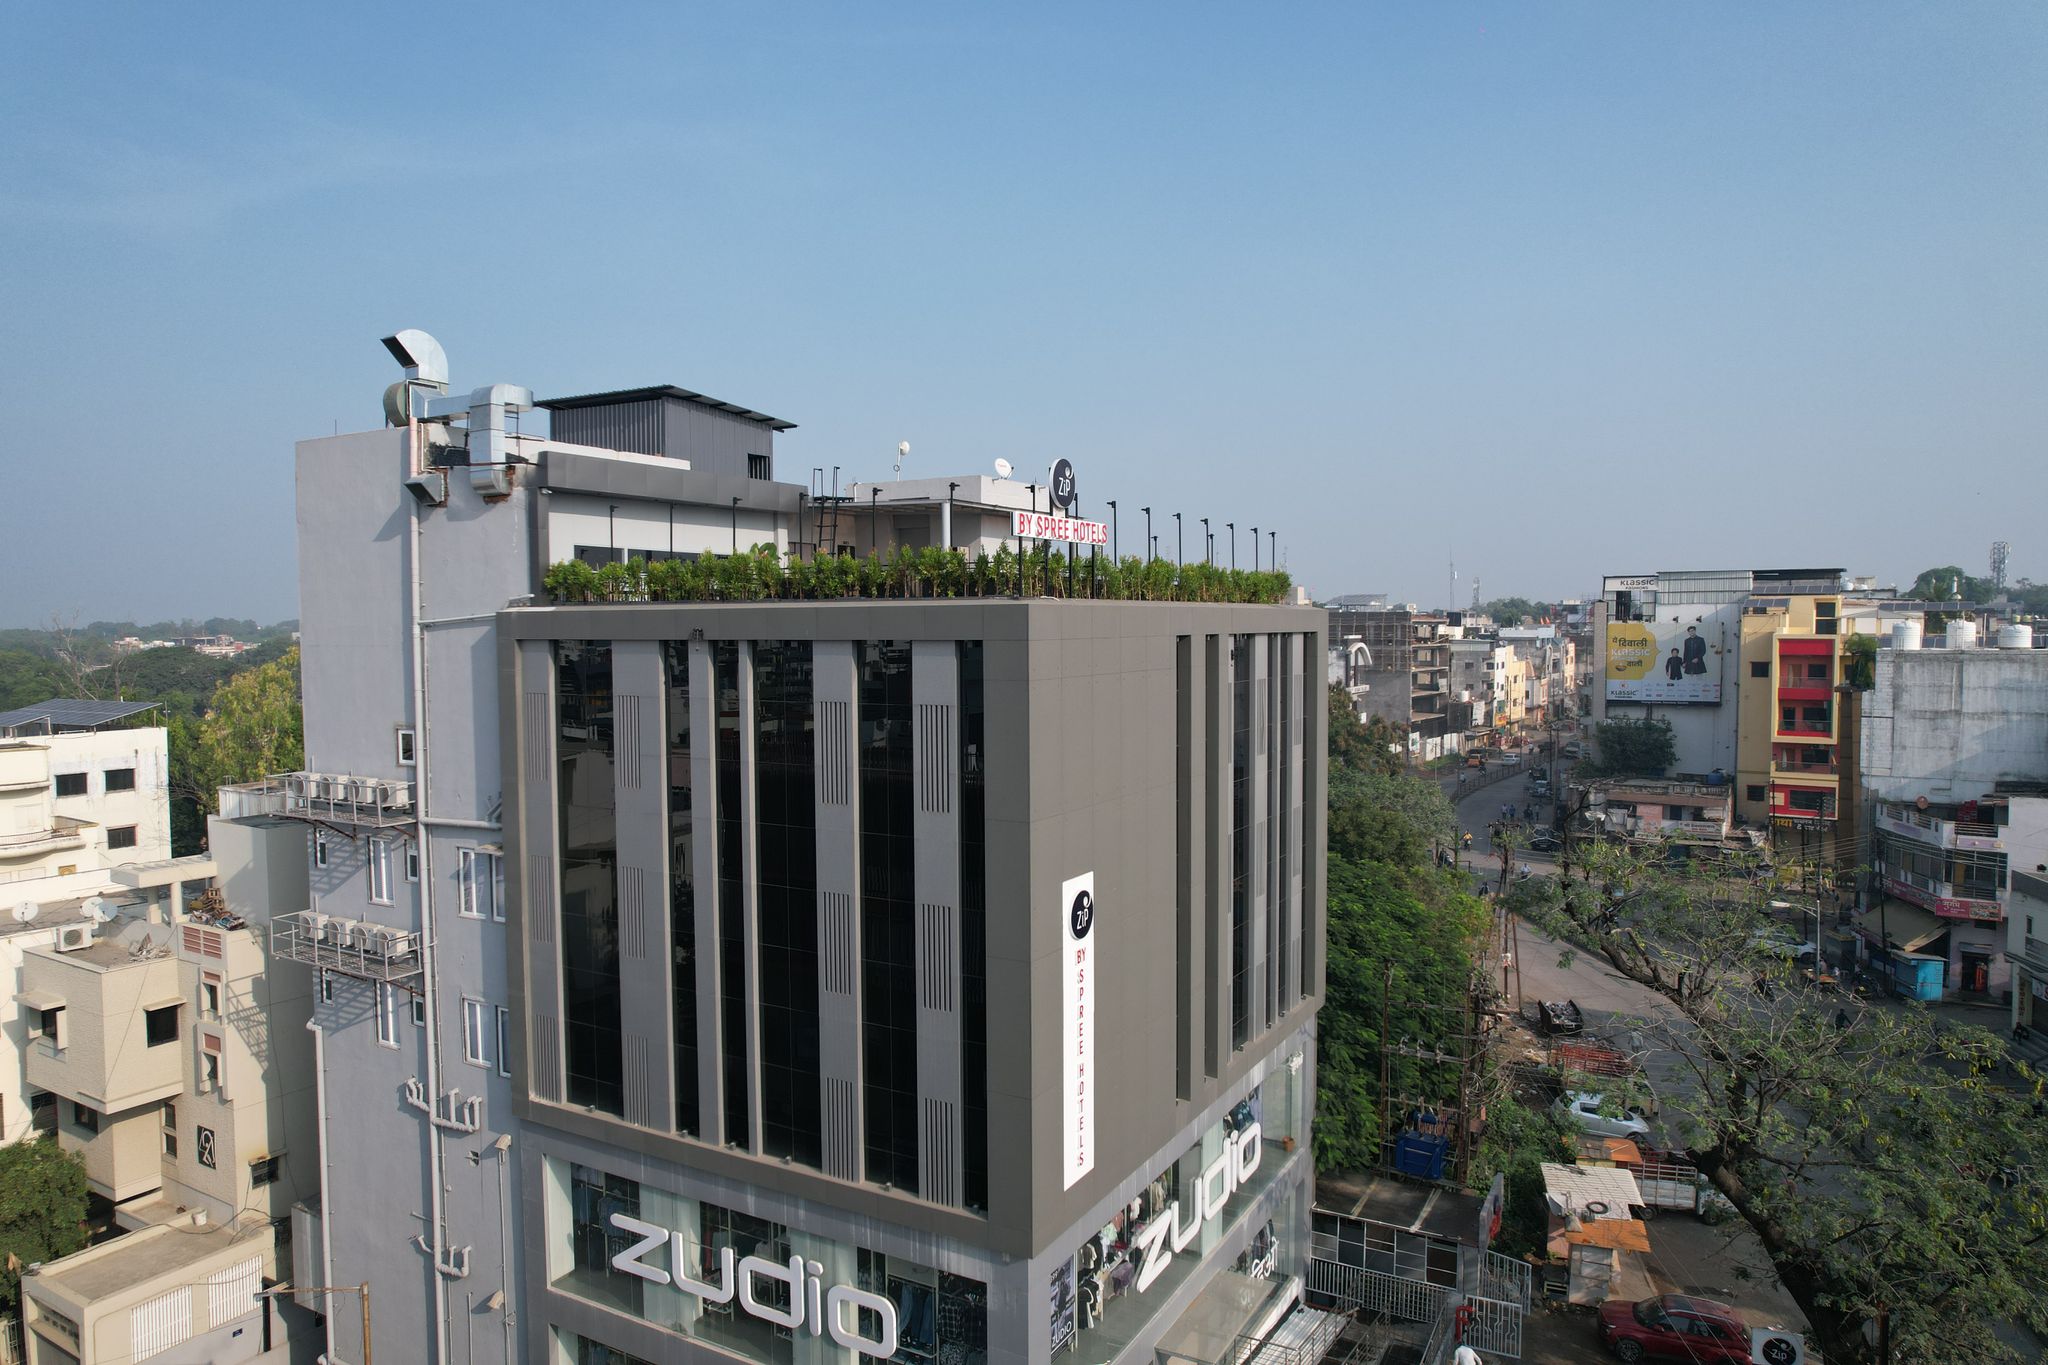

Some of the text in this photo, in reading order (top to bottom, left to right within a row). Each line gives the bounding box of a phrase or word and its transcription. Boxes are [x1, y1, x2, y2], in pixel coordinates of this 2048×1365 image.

[1018, 513, 1108, 544] BY SPREE HOTELS
[1618, 637, 1648, 648] दिवाली
[1076, 948, 1086, 966] BY
[1052, 1321, 1072, 1348] ZUDIO
